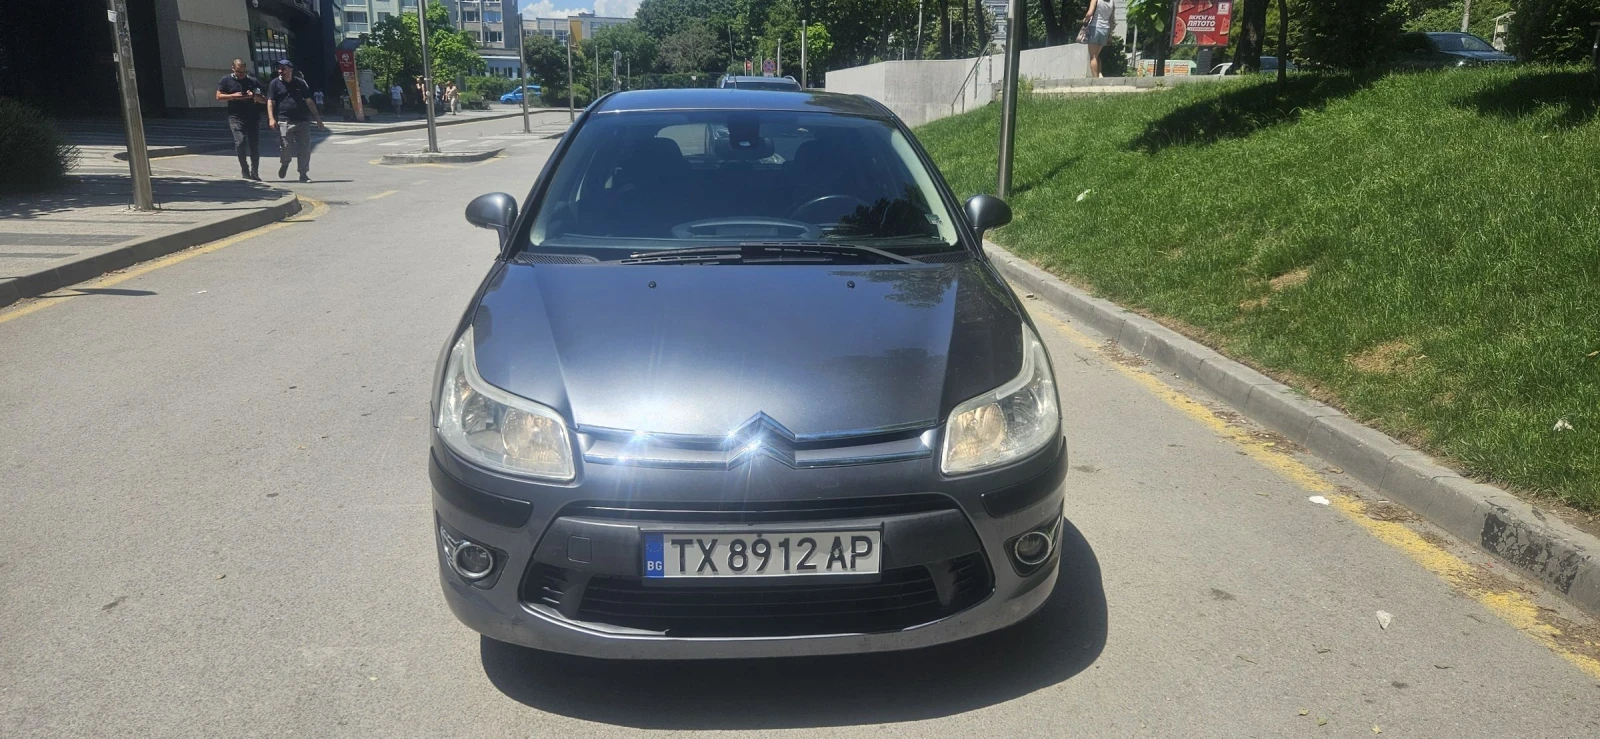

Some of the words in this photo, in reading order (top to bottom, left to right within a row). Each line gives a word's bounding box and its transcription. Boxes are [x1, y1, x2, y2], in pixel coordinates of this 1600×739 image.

[647, 560, 663, 571] BG
[670, 538, 719, 573] TX
[727, 537, 818, 572] 8912
[825, 535, 873, 571] AP
